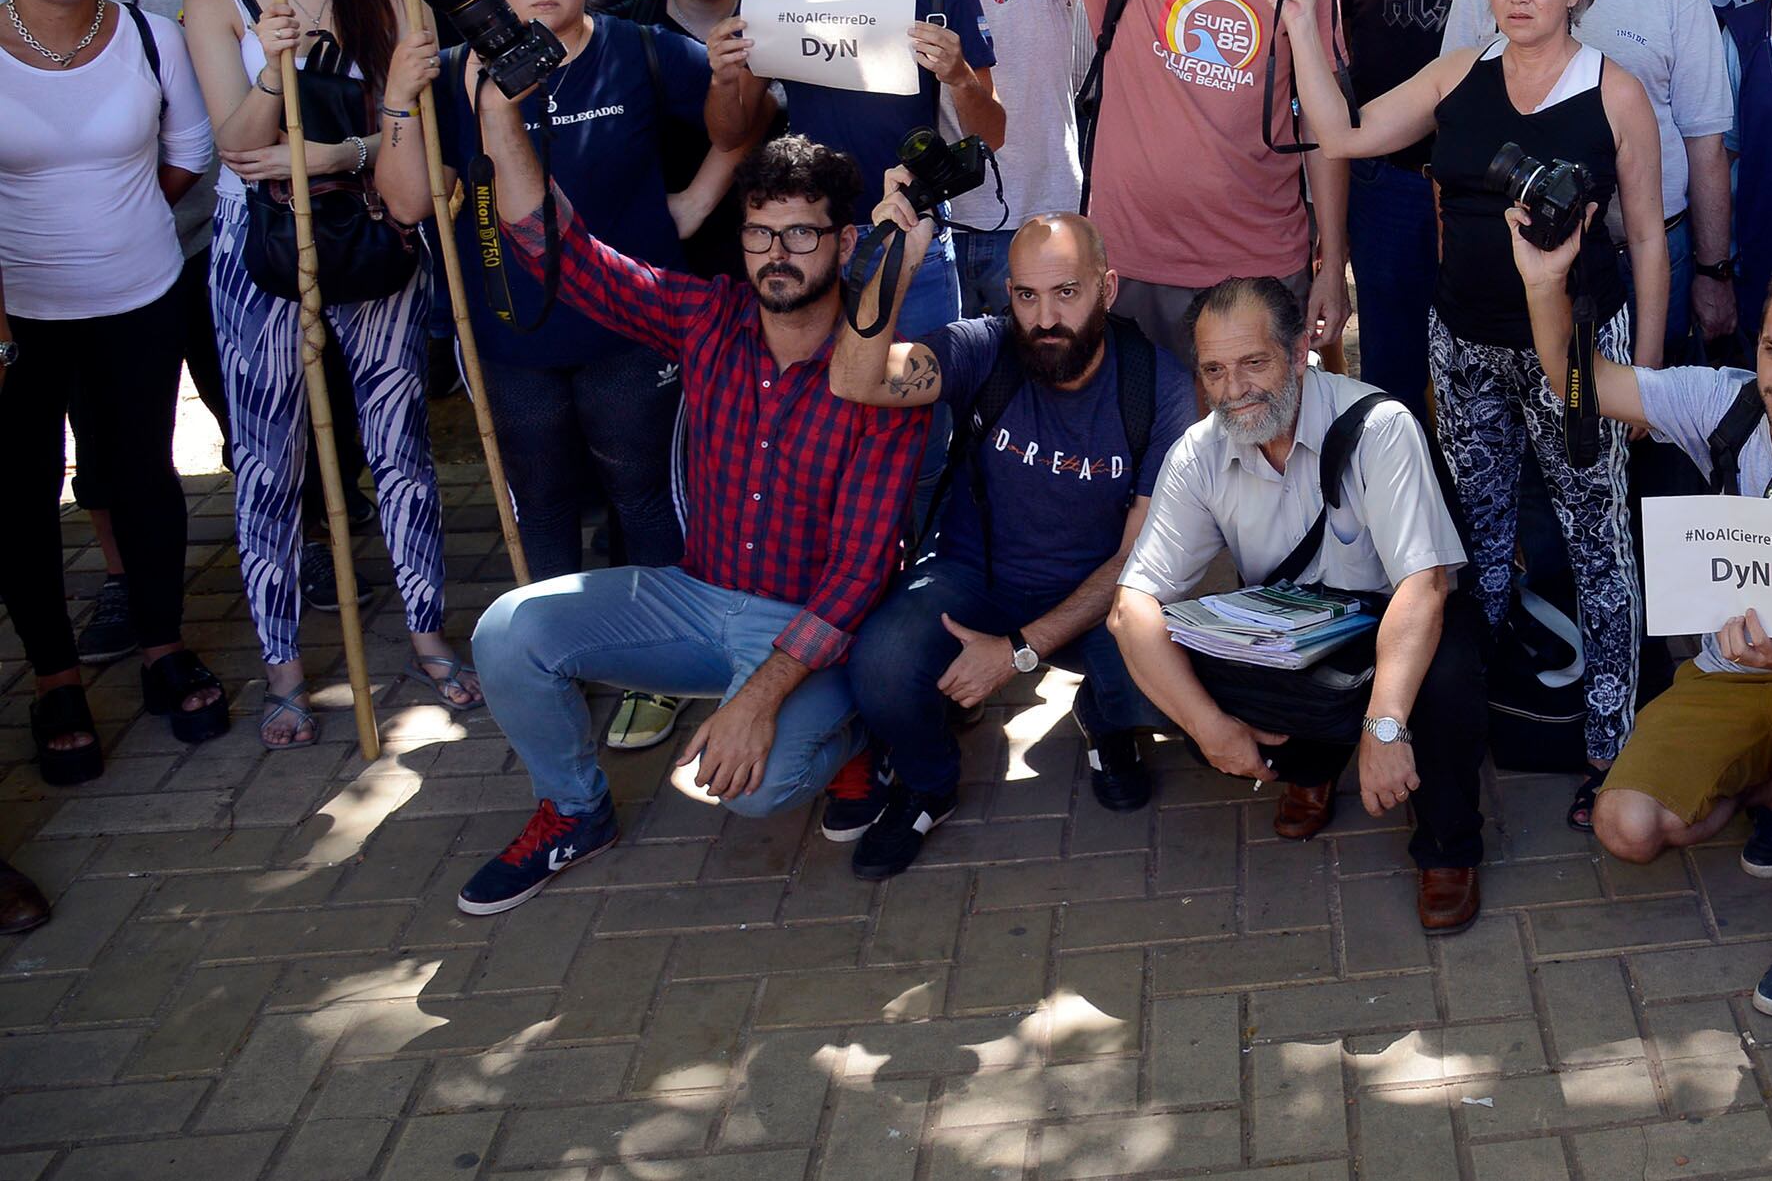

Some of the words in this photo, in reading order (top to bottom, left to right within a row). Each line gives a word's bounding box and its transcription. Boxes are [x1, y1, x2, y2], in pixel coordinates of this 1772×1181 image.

[778, 12, 876, 26] #NoAlCierreDe
[1194, 12, 1247, 34] SURF
[1217, 32, 1250, 54] 82
[1616, 29, 1647, 46] INSIDE
[801, 37, 858, 62] DyN
[1165, 62, 1203, 82] LNG
[1206, 75, 1246, 92] BEACH
[552, 105, 624, 126] DELEGADOS
[477, 185, 489, 225] Nikon
[479, 228, 500, 267] D750
[1711, 557, 1770, 589] DyN
